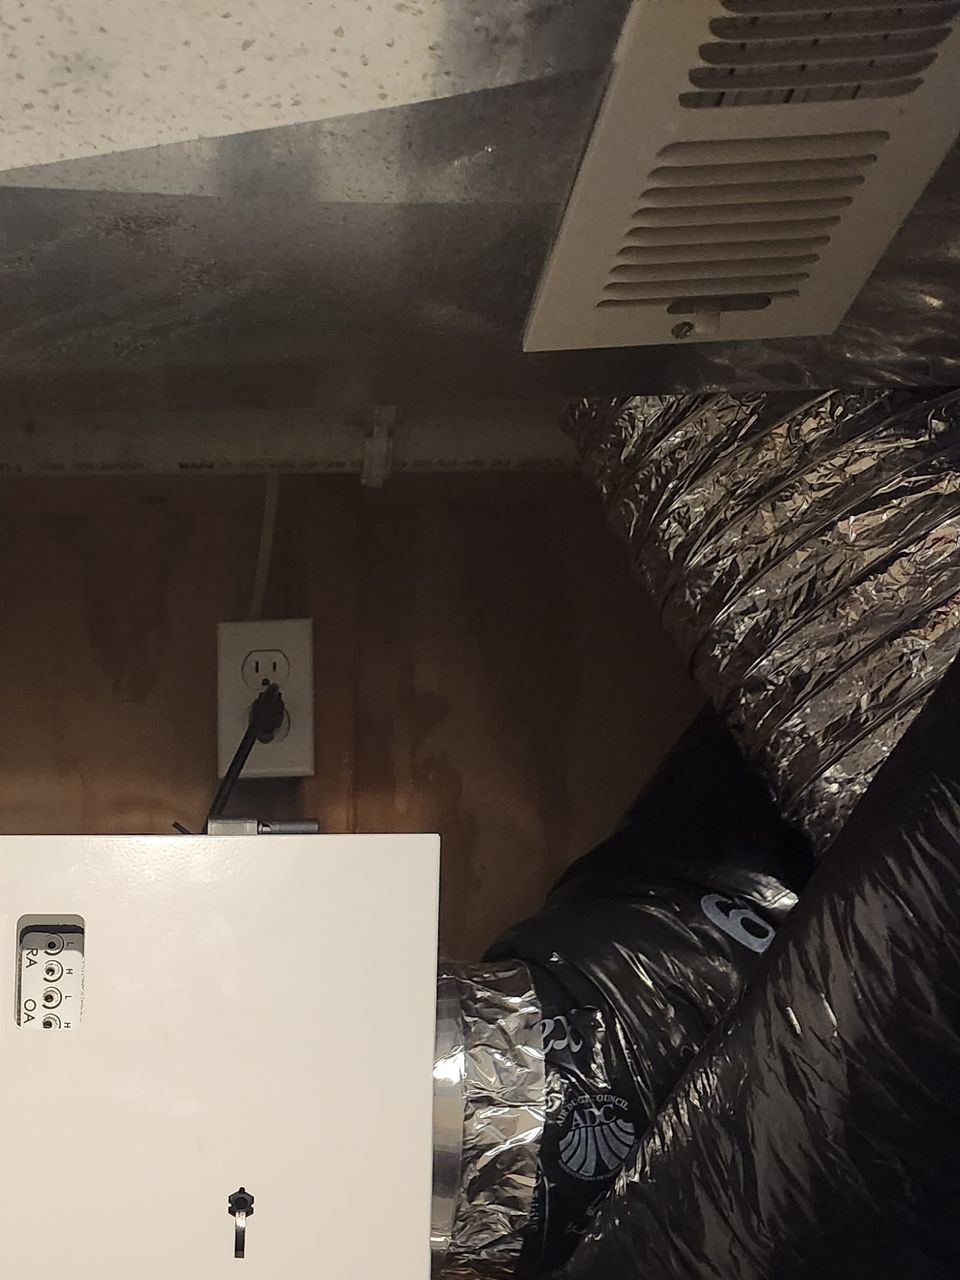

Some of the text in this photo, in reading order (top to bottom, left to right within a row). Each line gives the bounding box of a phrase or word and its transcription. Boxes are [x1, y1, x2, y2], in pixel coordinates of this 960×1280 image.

[26, 948, 38, 968] RA
[23, 999, 36, 1024] OA
[555, 1109, 568, 1127] AIR
[572, 1103, 616, 1130] ADC
